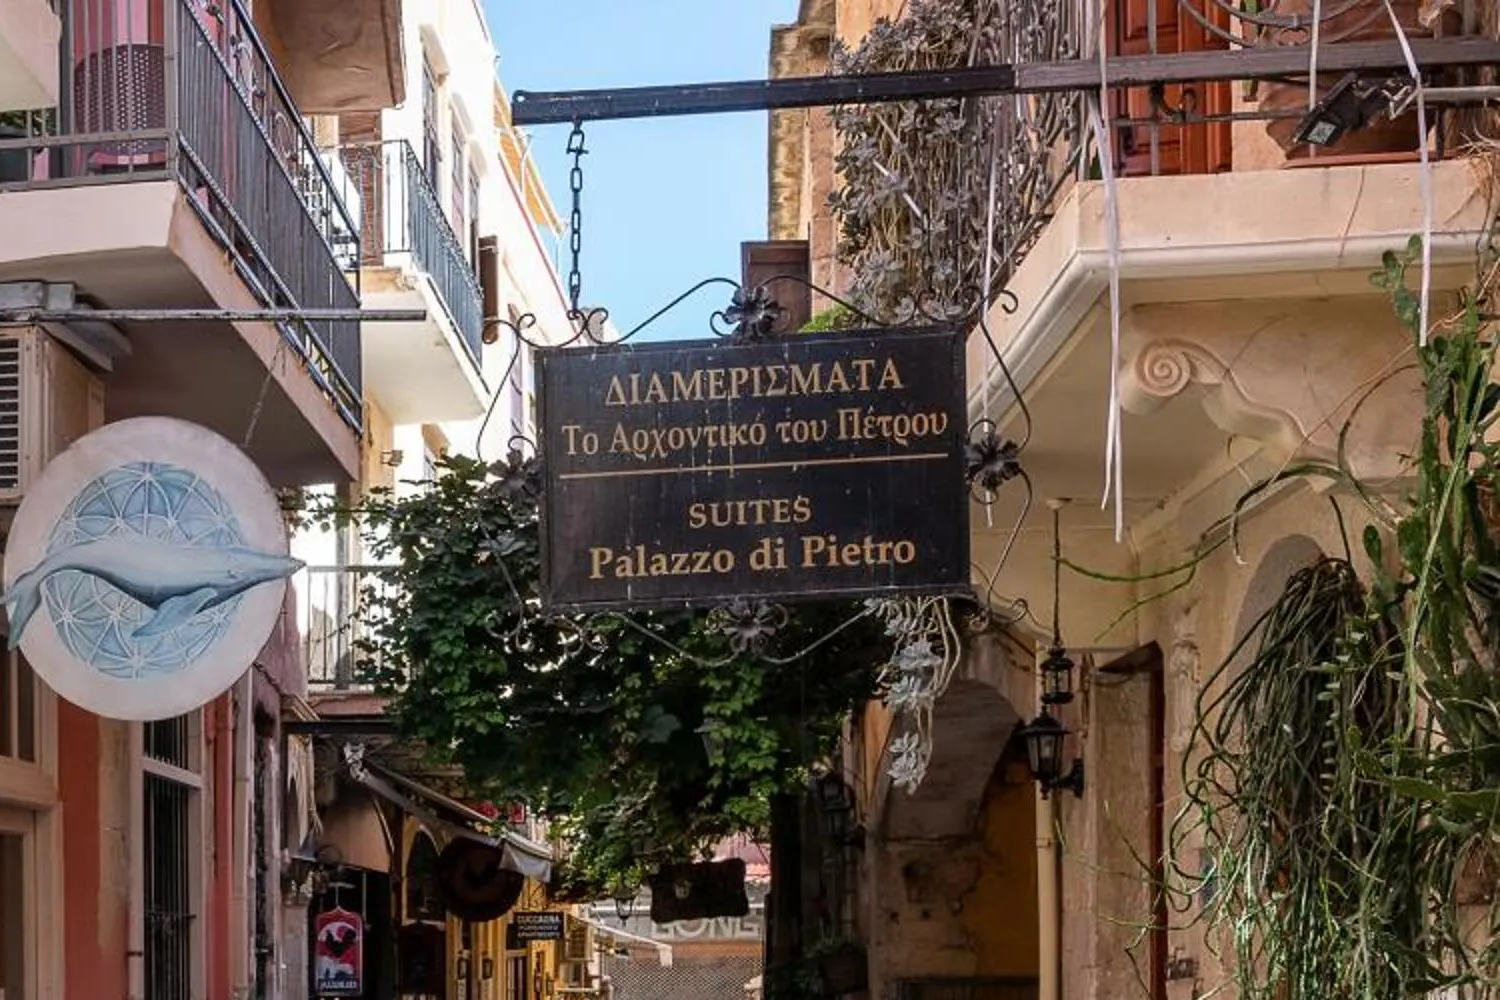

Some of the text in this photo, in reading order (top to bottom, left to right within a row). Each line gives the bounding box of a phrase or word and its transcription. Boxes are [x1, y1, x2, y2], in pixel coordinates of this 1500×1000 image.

[605, 357, 905, 407] ΔΙΑΜΕΡΙΣΜΑΤΑ
[609, 411, 767, 462] Αρχοντικό
[775, 417, 828, 445] του
[837, 405, 948, 446] Πέτρου
[688, 496, 813, 529] SUITES
[589, 534, 916, 580] Palazzo di Pietro
